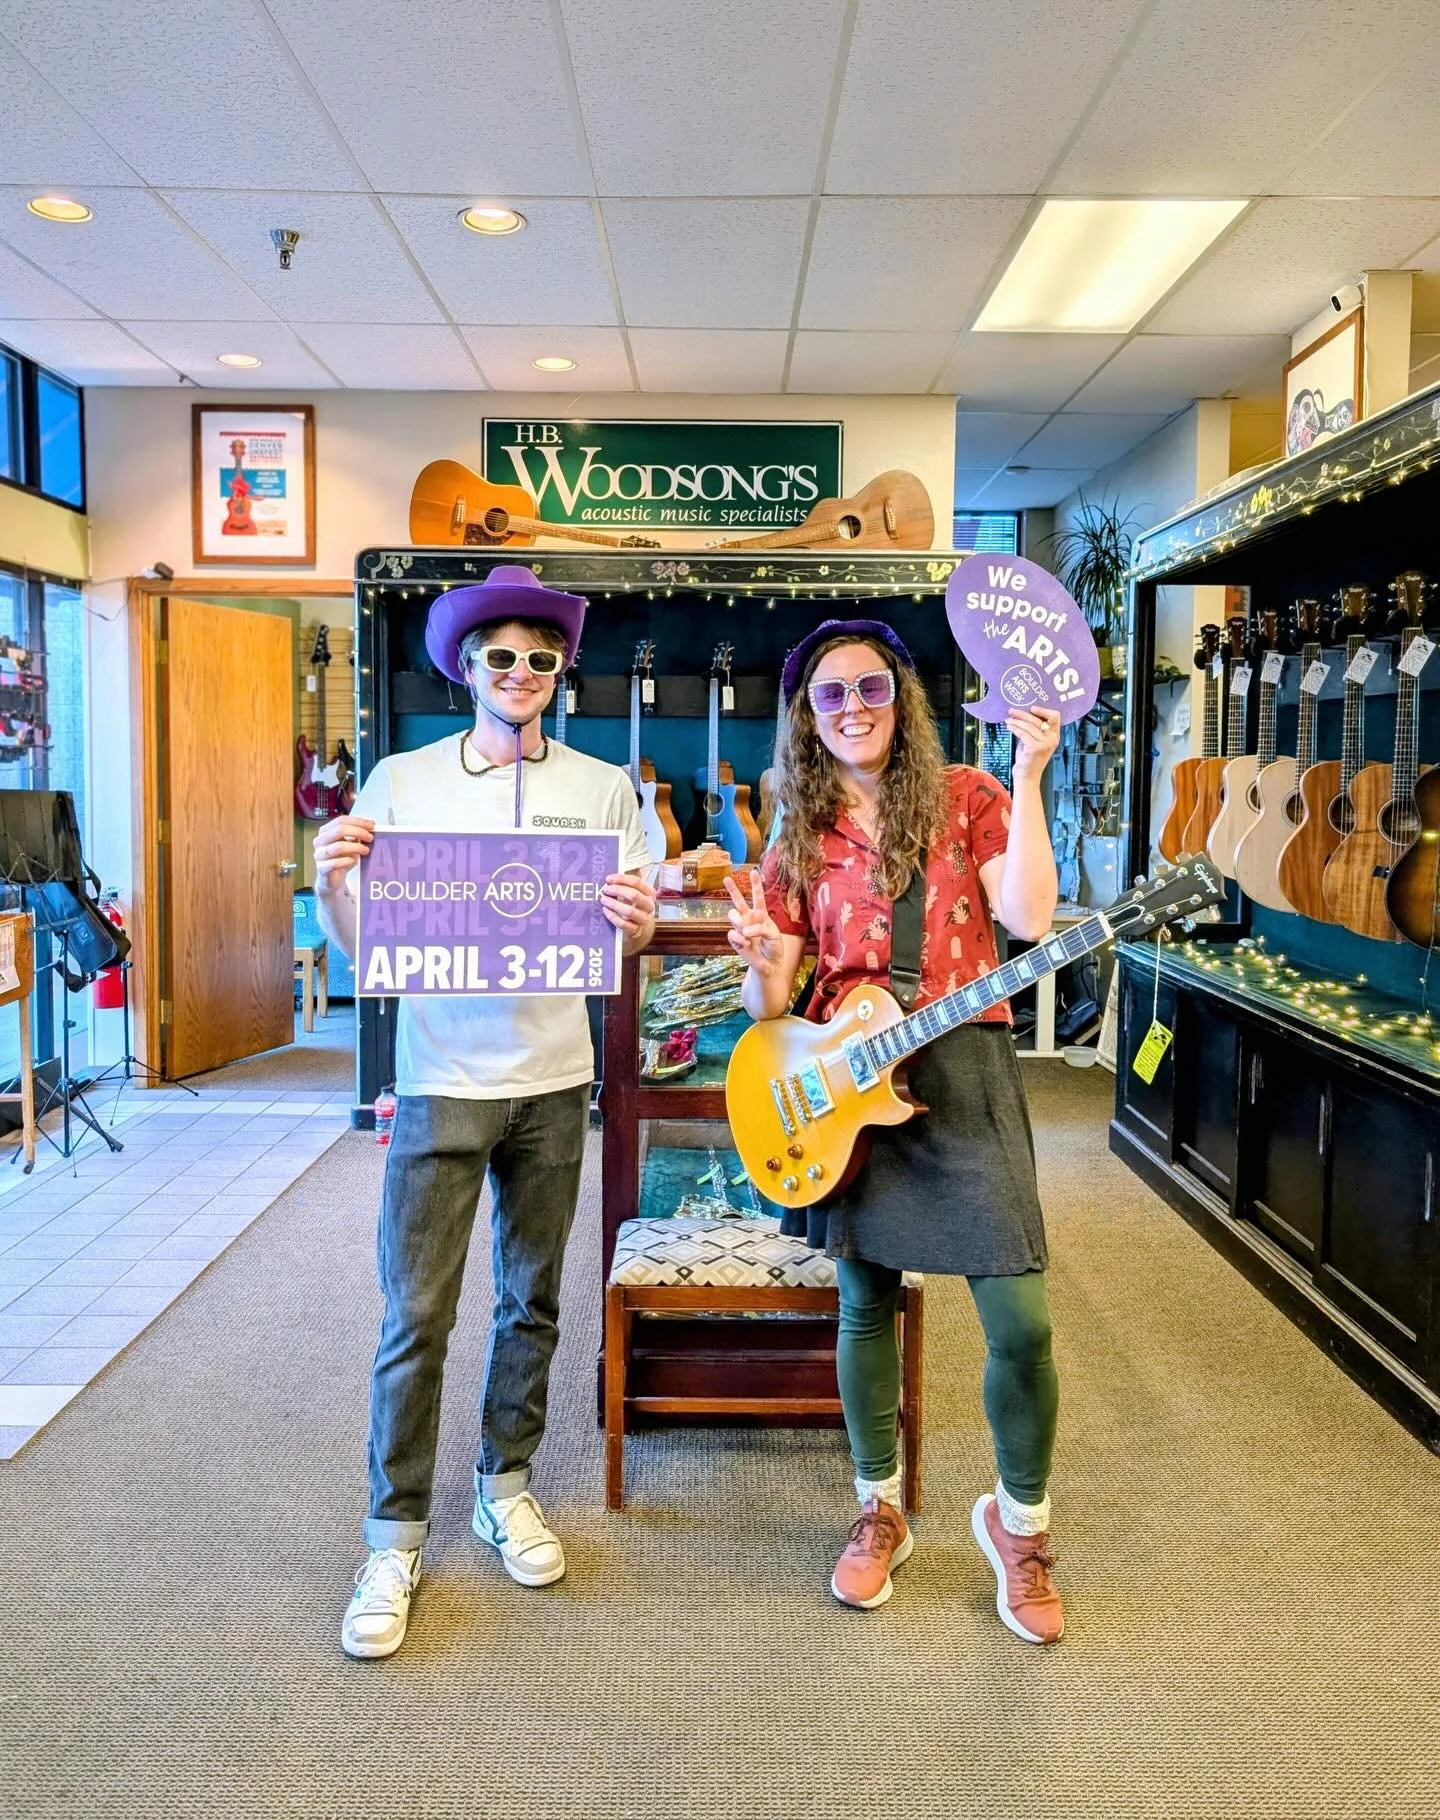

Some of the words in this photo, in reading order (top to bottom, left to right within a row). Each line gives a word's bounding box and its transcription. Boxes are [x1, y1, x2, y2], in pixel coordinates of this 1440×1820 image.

[514, 424, 563, 443] H.B.
[500, 446, 819, 516] WOODSONG'S
[581, 505, 651, 521] acoustic
[660, 505, 711, 521] music
[720, 505, 808, 525] specialists
[988, 565, 1027, 591] We
[966, 592, 1068, 633] support
[983, 619, 1010, 639] the
[1002, 625, 1085, 702] ARTS!
[1004, 680, 1025, 703] WEEK
[1011, 675, 1029, 694] ARTS
[1018, 667, 1049, 703] BOULDER
[532, 815, 587, 829] SQUASH
[366, 840, 491, 883] APRIL
[369, 881, 477, 901] BOULDER
[483, 881, 535, 901] ARTS
[363, 946, 489, 989] APRIL
[498, 945, 585, 989] 3-12
[588, 947, 603, 987] 2026
